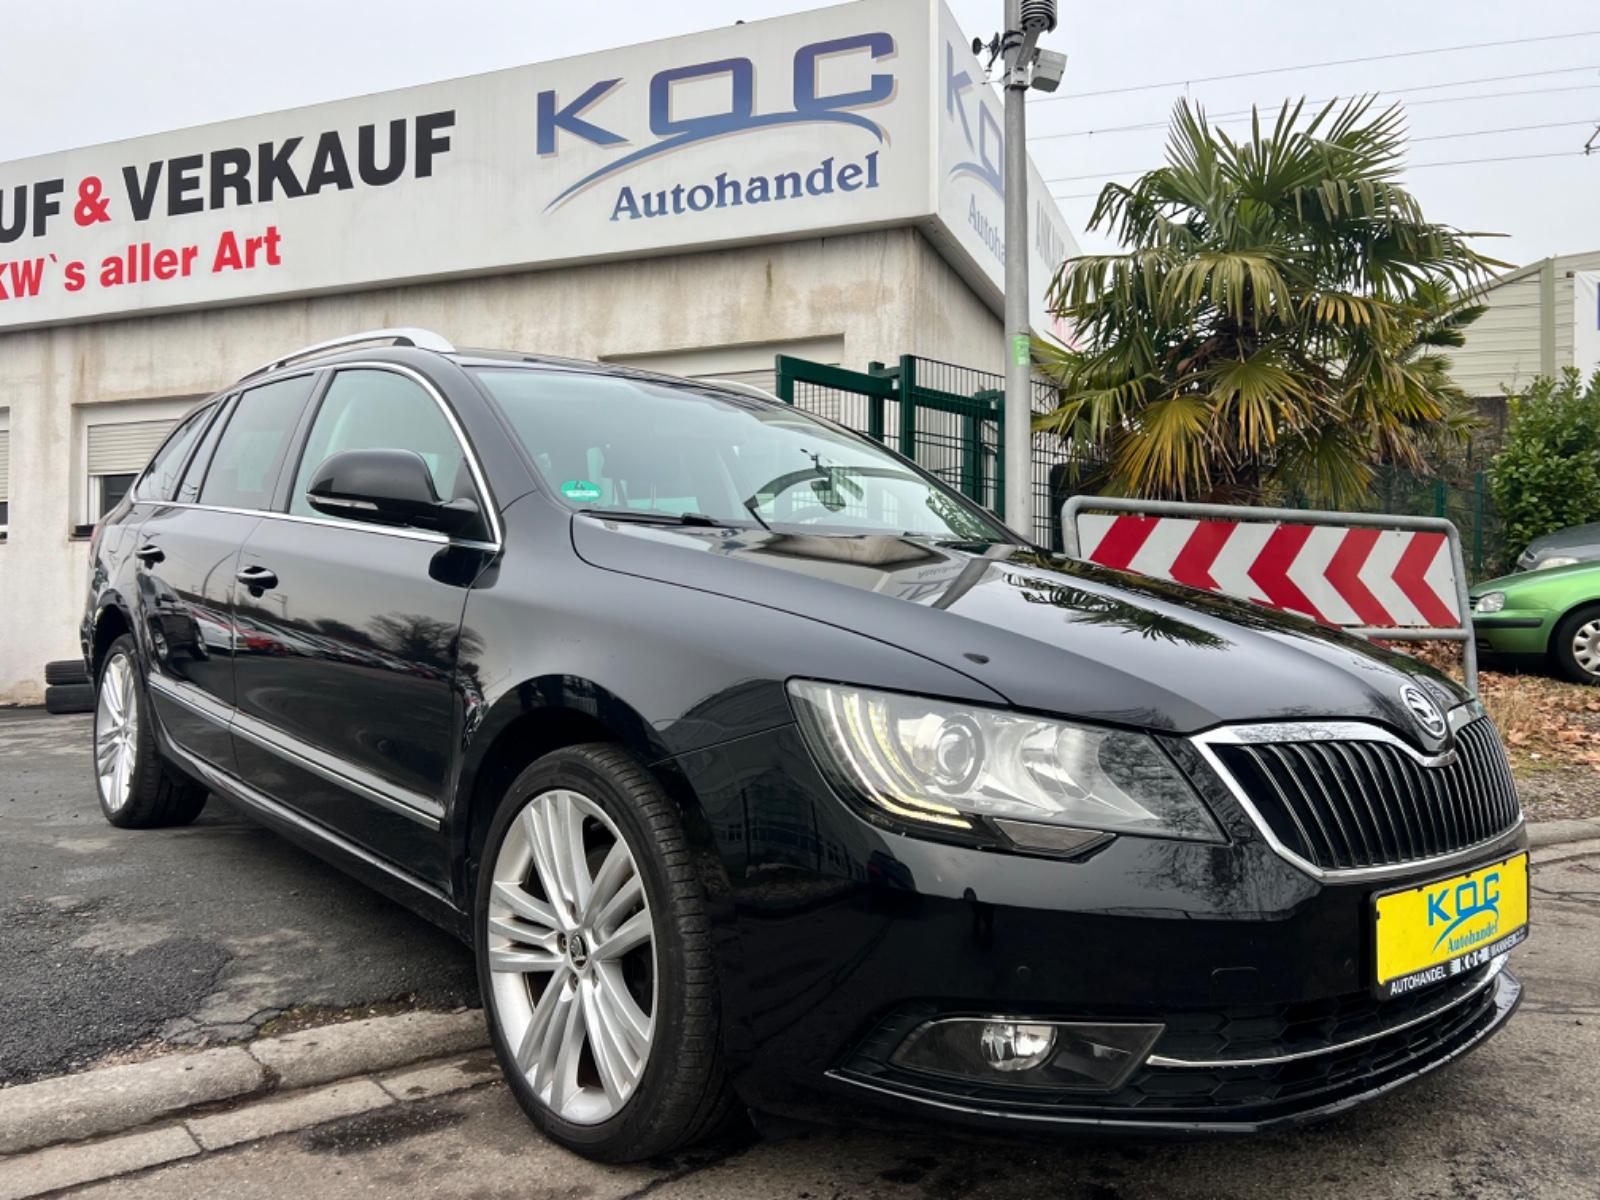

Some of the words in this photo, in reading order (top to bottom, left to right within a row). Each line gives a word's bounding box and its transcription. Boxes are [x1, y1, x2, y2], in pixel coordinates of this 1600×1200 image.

[536, 32, 898, 157] KOC
[946, 40, 1004, 180] KO
[74, 175, 112, 228] &
[122, 109, 456, 221] VERKAUF
[609, 150, 880, 221] Autohandel
[100, 242, 198, 288] aller
[212, 226, 282, 273] Art
[968, 193, 1004, 265] Autoh
[1428, 872, 1500, 926] KOC
[1448, 921, 1498, 953] Autohandel
[1390, 966, 1447, 996] AUTOHANDEL
